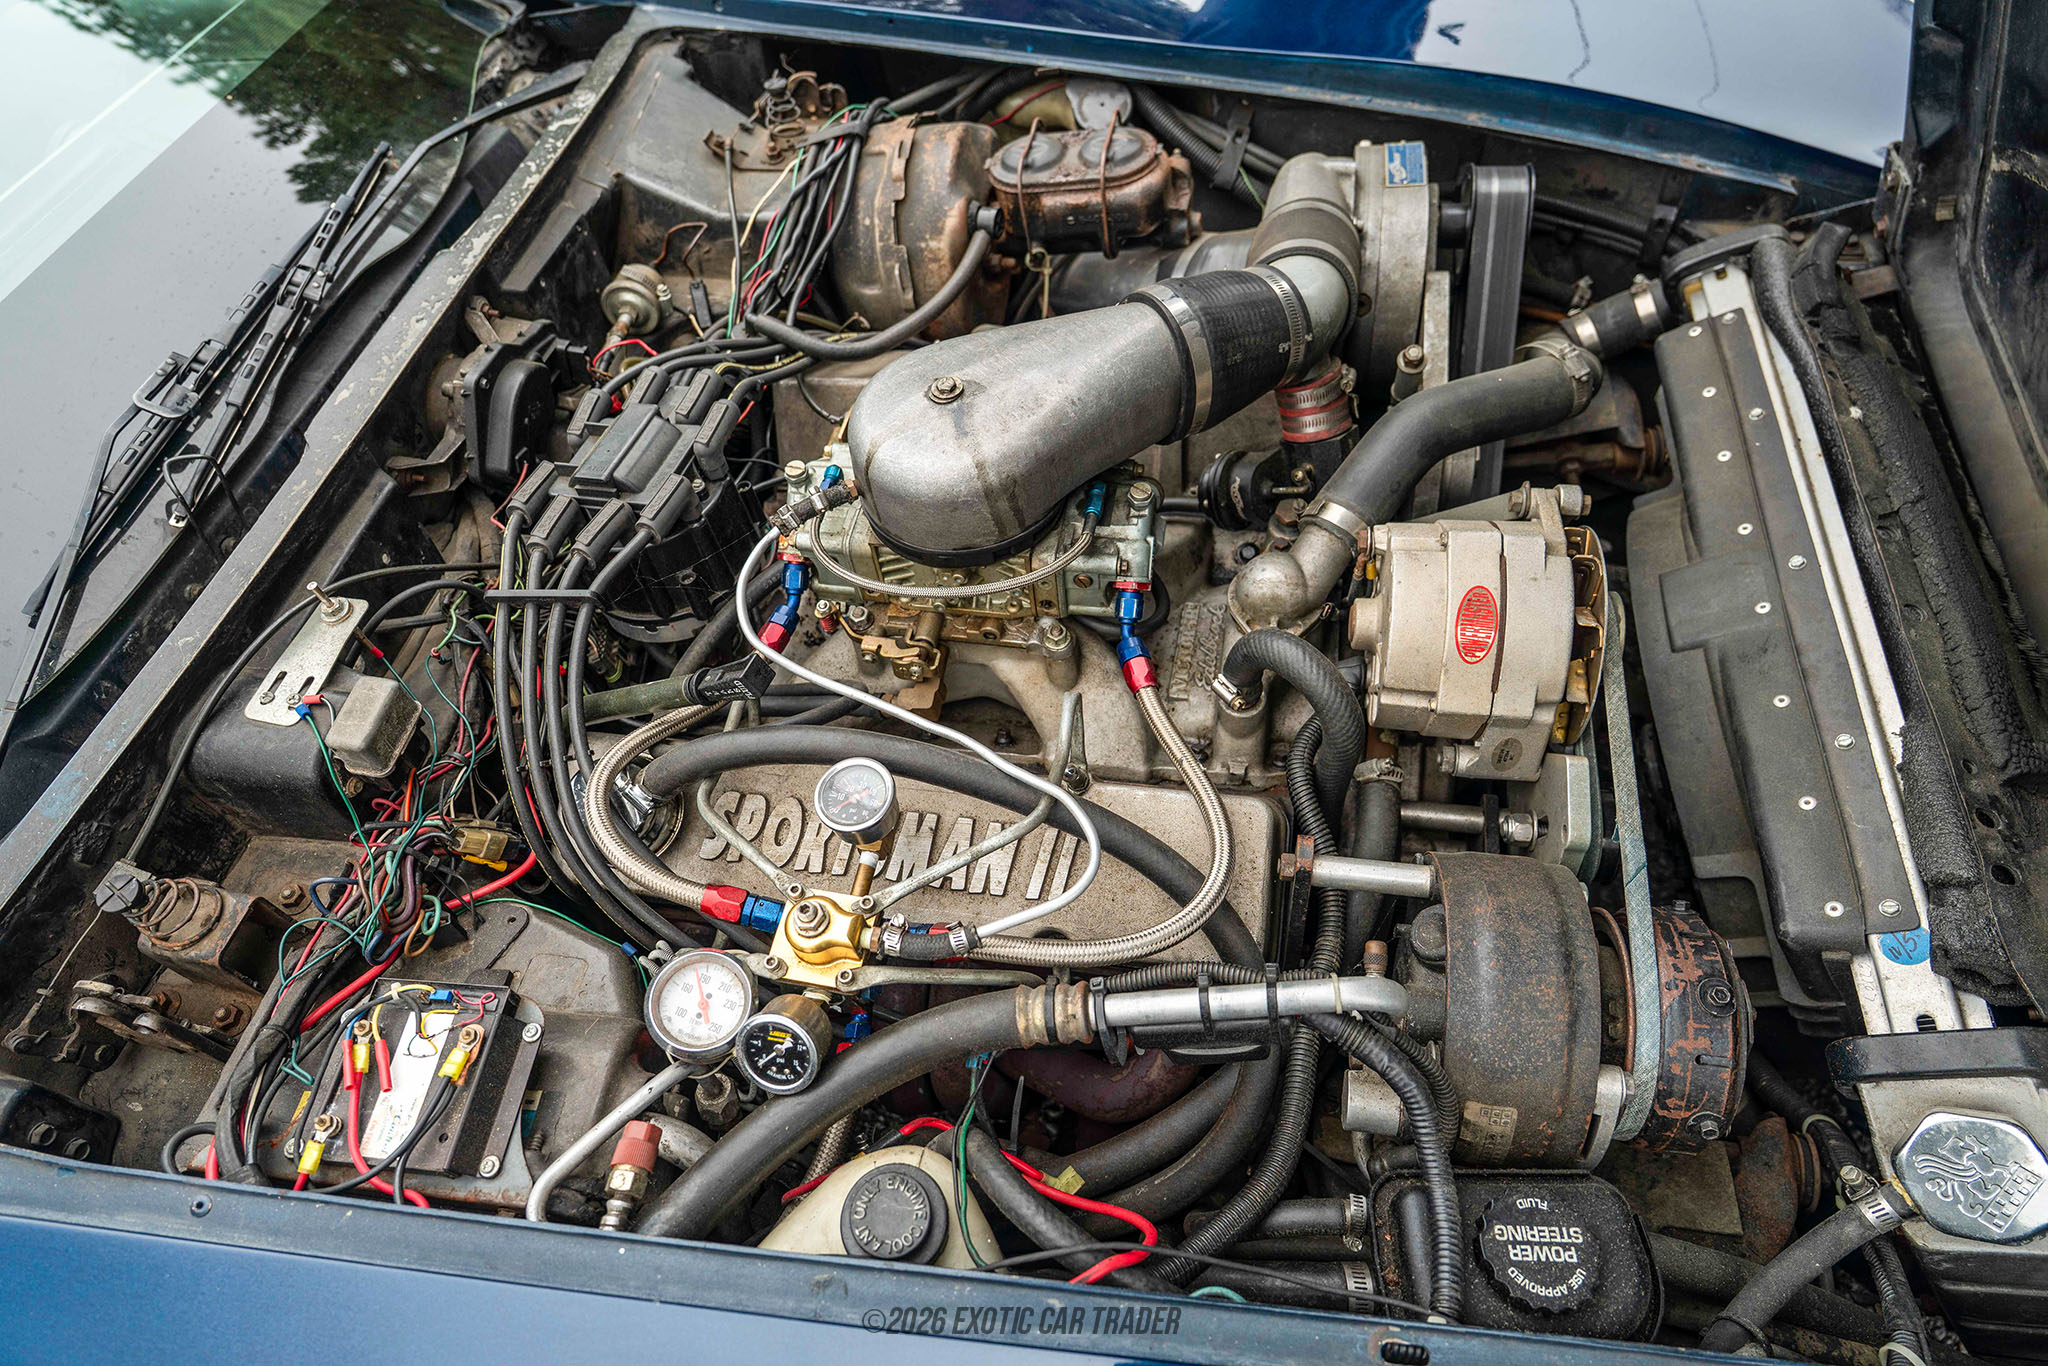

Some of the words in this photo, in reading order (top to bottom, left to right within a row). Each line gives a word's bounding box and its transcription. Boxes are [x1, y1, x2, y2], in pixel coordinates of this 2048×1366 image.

[1460, 591, 1494, 658] POWERMASTER
[1194, 603, 1226, 691] Edelbrock
[699, 790, 1019, 896] SPORMAN
[680, 982, 694, 994] 160
[700, 973, 712, 985] 190
[718, 981, 732, 994] 210
[674, 1006, 688, 1018] 100
[723, 999, 737, 1011] 230
[708, 1022, 723, 1034] 250
[853, 1179, 881, 1220] ONLY
[886, 1175, 928, 1221] ENGINE
[1516, 1198, 1549, 1211] FLUID
[854, 1224, 924, 1255] COOLANT
[1494, 1225, 1583, 1244] STEERING
[1507, 1244, 1578, 1263] POWER
[1507, 1266, 1568, 1297] APPROVED
[1568, 1268, 1587, 1291] USE
